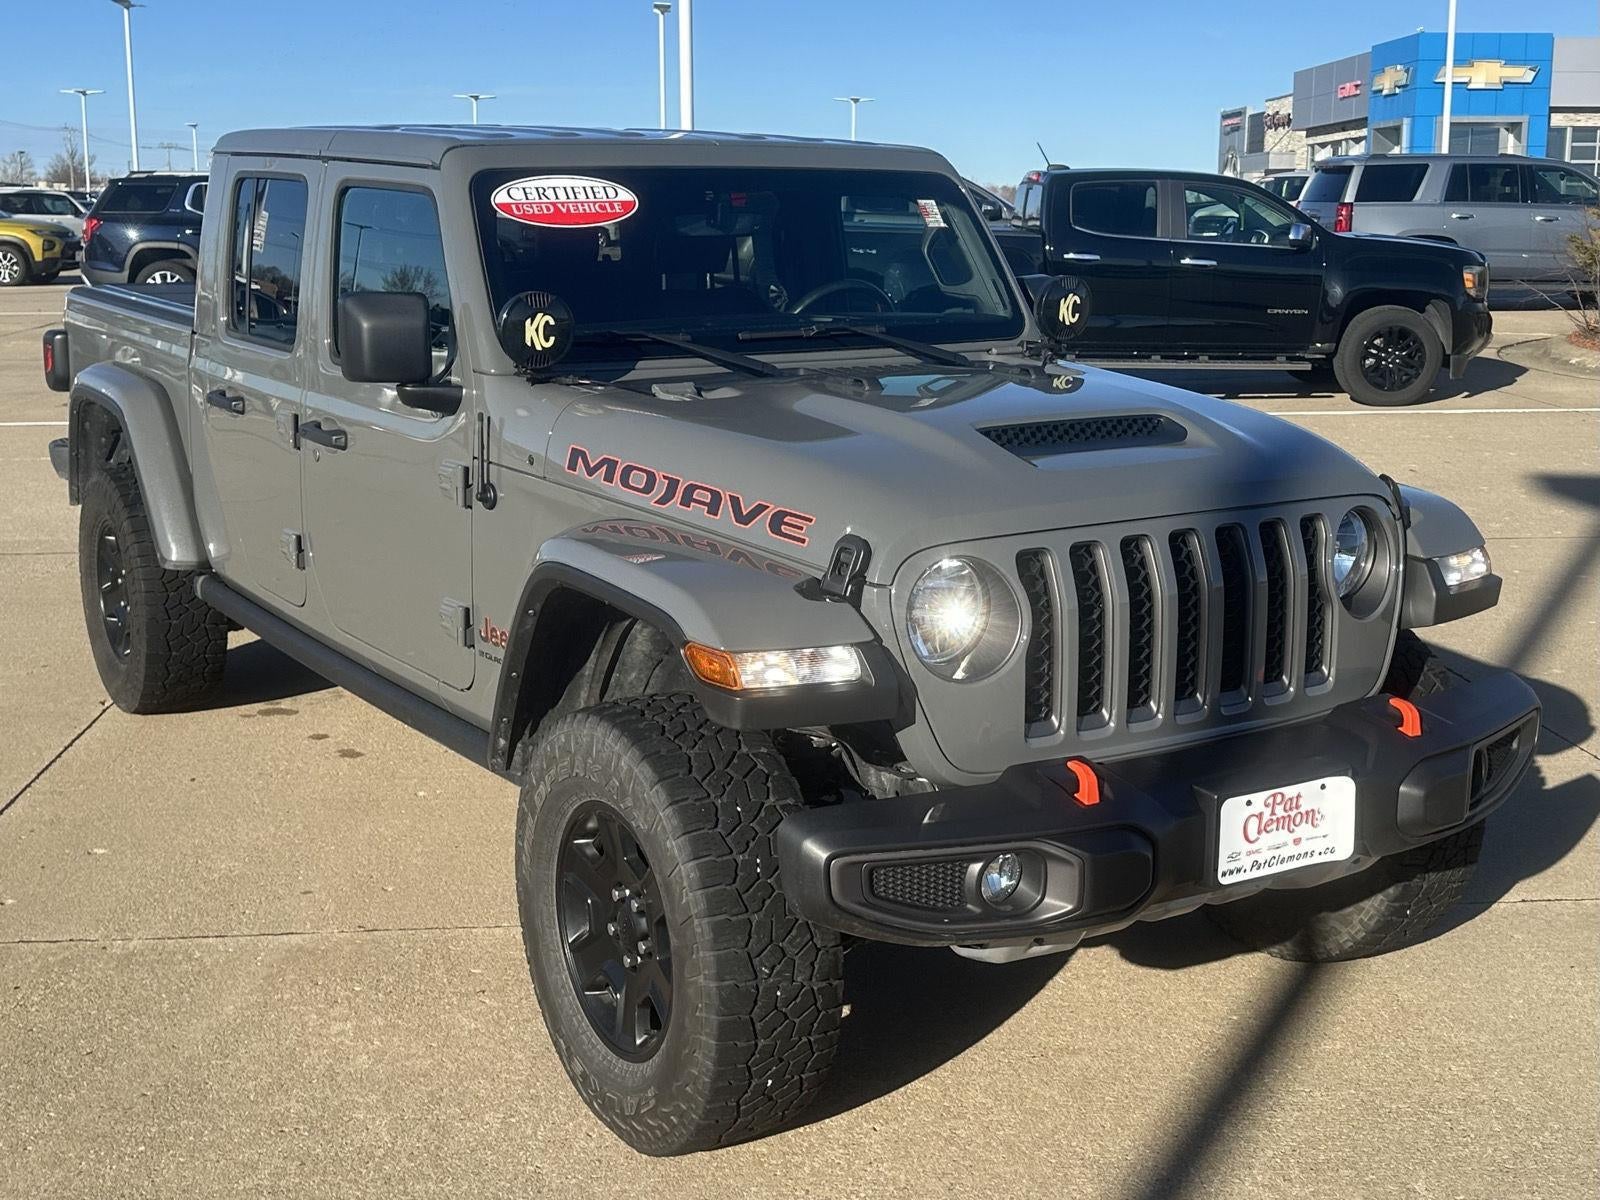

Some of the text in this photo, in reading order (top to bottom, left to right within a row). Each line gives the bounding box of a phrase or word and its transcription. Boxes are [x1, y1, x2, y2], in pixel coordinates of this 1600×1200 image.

[507, 186, 619, 201] CERTIFIED
[511, 202, 624, 215] USED VEHICLE
[1058, 293, 1081, 325] KC
[525, 312, 555, 351] KC
[565, 445, 816, 548] MOJAVE
[479, 616, 510, 650] Jee
[1264, 791, 1302, 816] Pat
